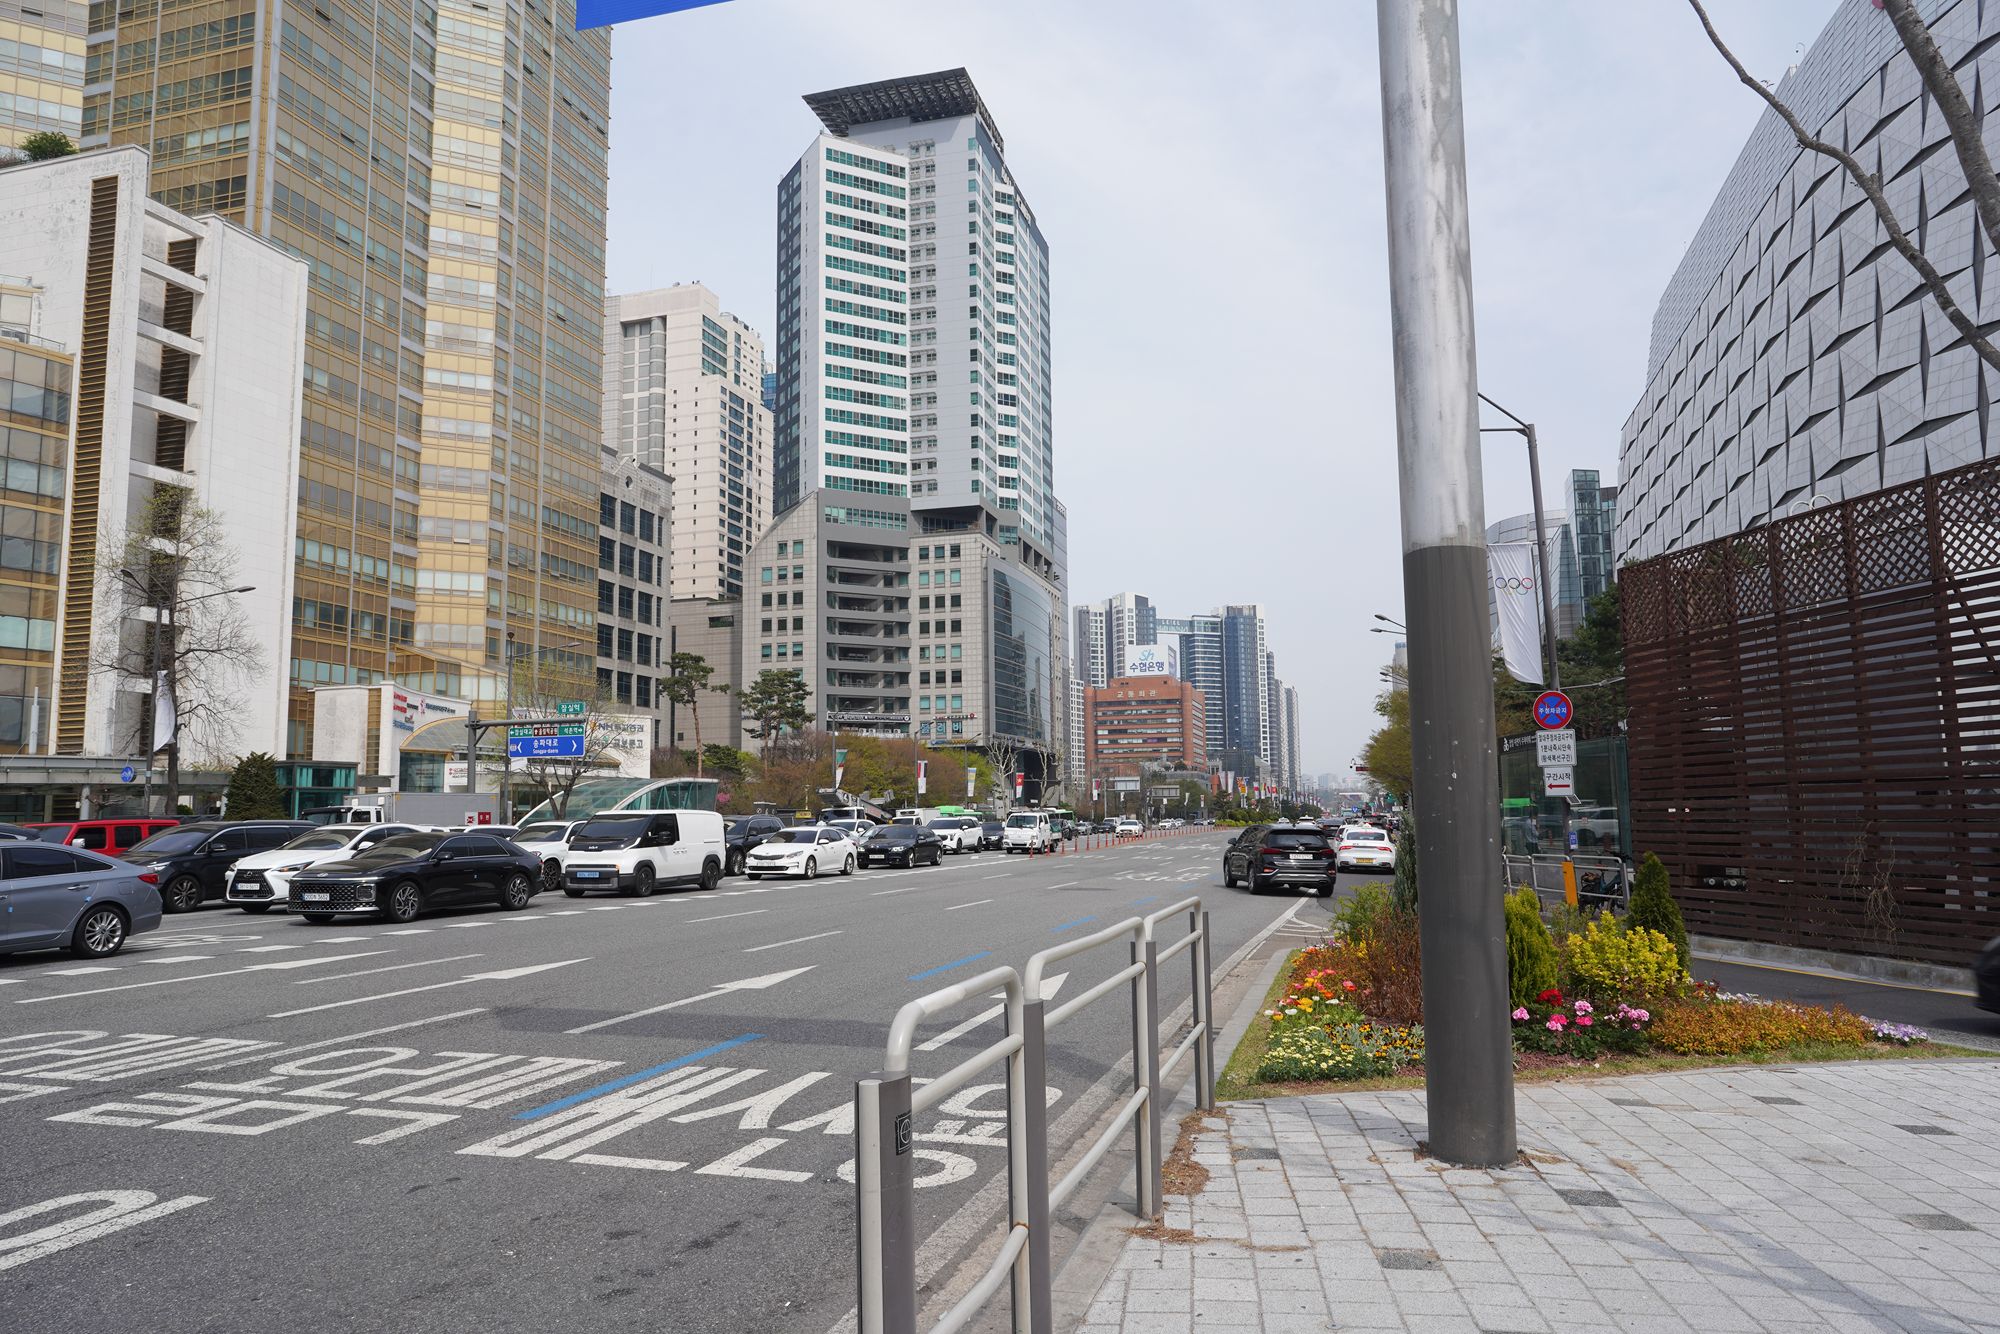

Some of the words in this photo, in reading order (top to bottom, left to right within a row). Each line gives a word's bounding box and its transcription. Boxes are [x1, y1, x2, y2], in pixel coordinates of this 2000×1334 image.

[1129, 661, 1165, 673] 수협은행
[560, 704, 581, 713] 잠실역
[514, 728, 533, 736] 잠실대교
[563, 727, 578, 735] 석촌역
[533, 739, 559, 749] 송파대로
[1540, 744, 1571, 752] 1분내즉시단속
